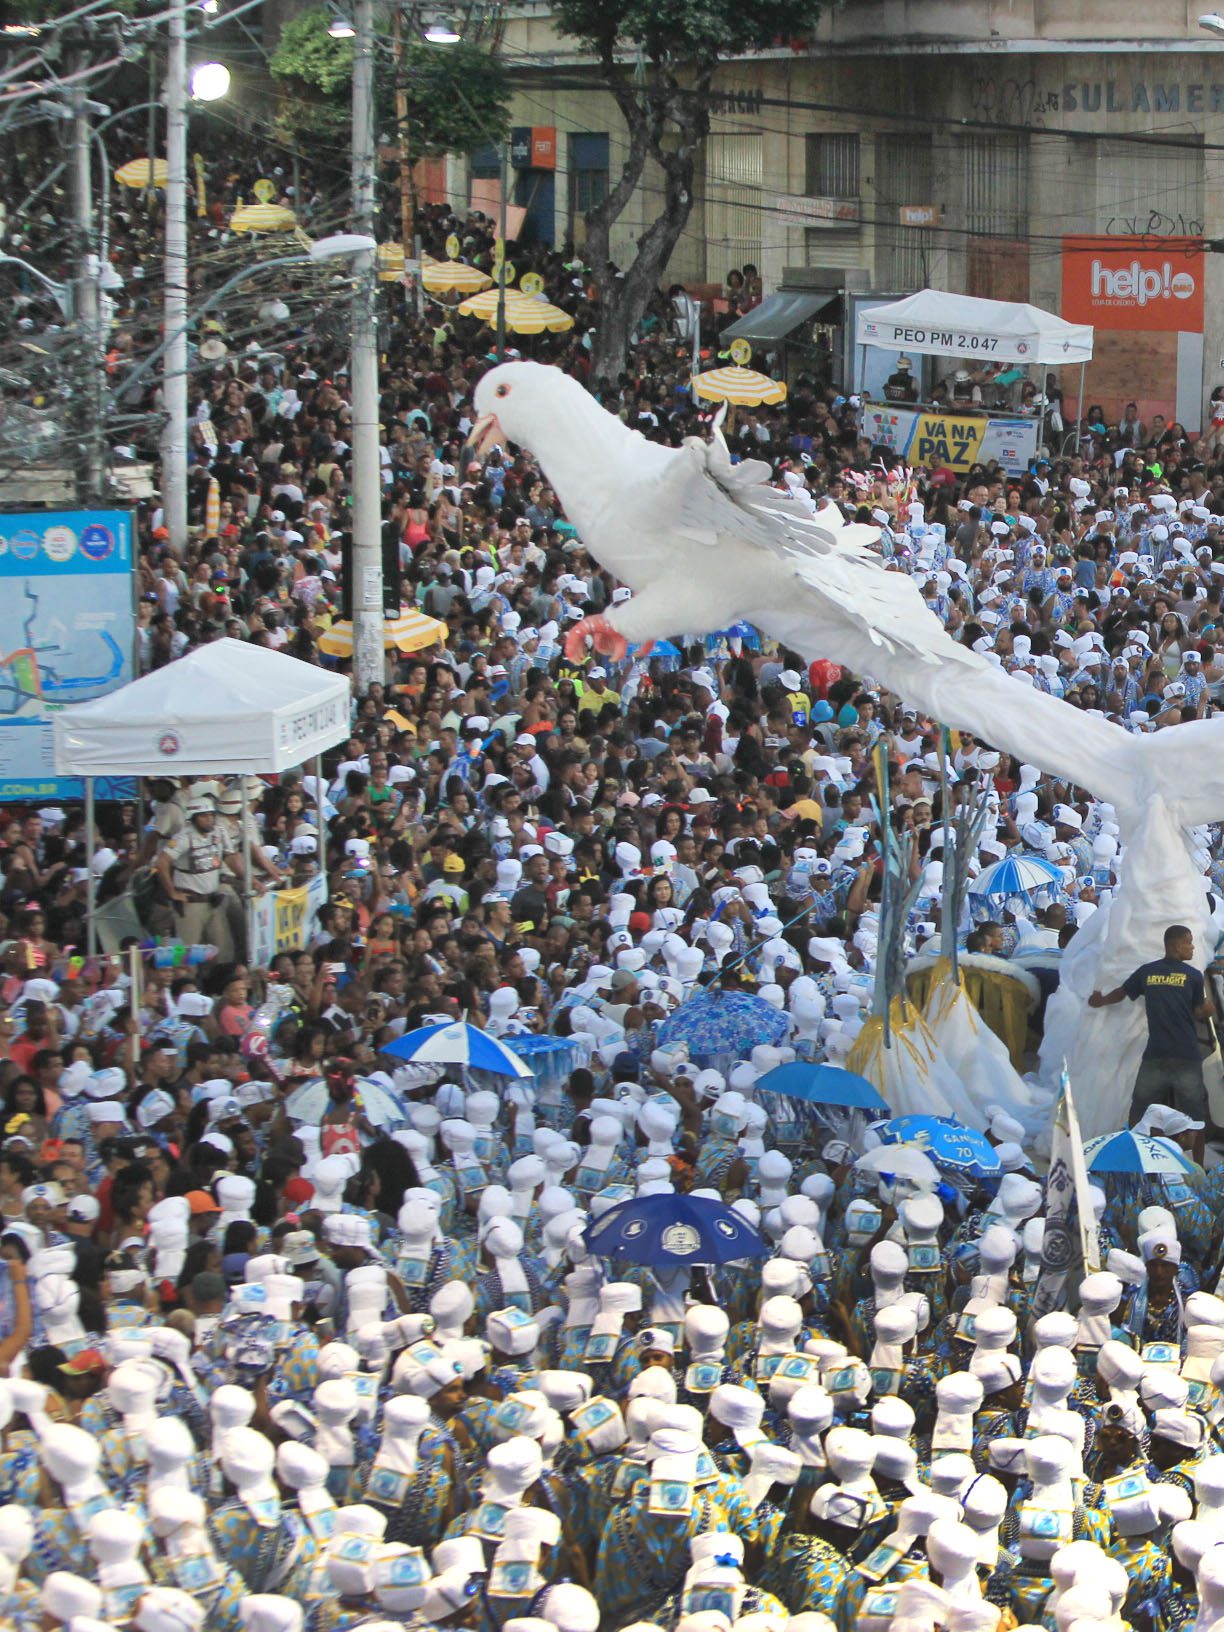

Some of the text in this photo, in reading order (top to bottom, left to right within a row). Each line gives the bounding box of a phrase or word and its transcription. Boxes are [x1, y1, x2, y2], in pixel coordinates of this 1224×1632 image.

[1063, 84, 1122, 113] SUL
[1091, 260, 1171, 306] help!
[894, 328, 998, 351] PEO PM 2.047
[924, 419, 978, 442] VÁ NA
[919, 437, 970, 465] PAZ
[955, 1147, 973, 1158] 70
